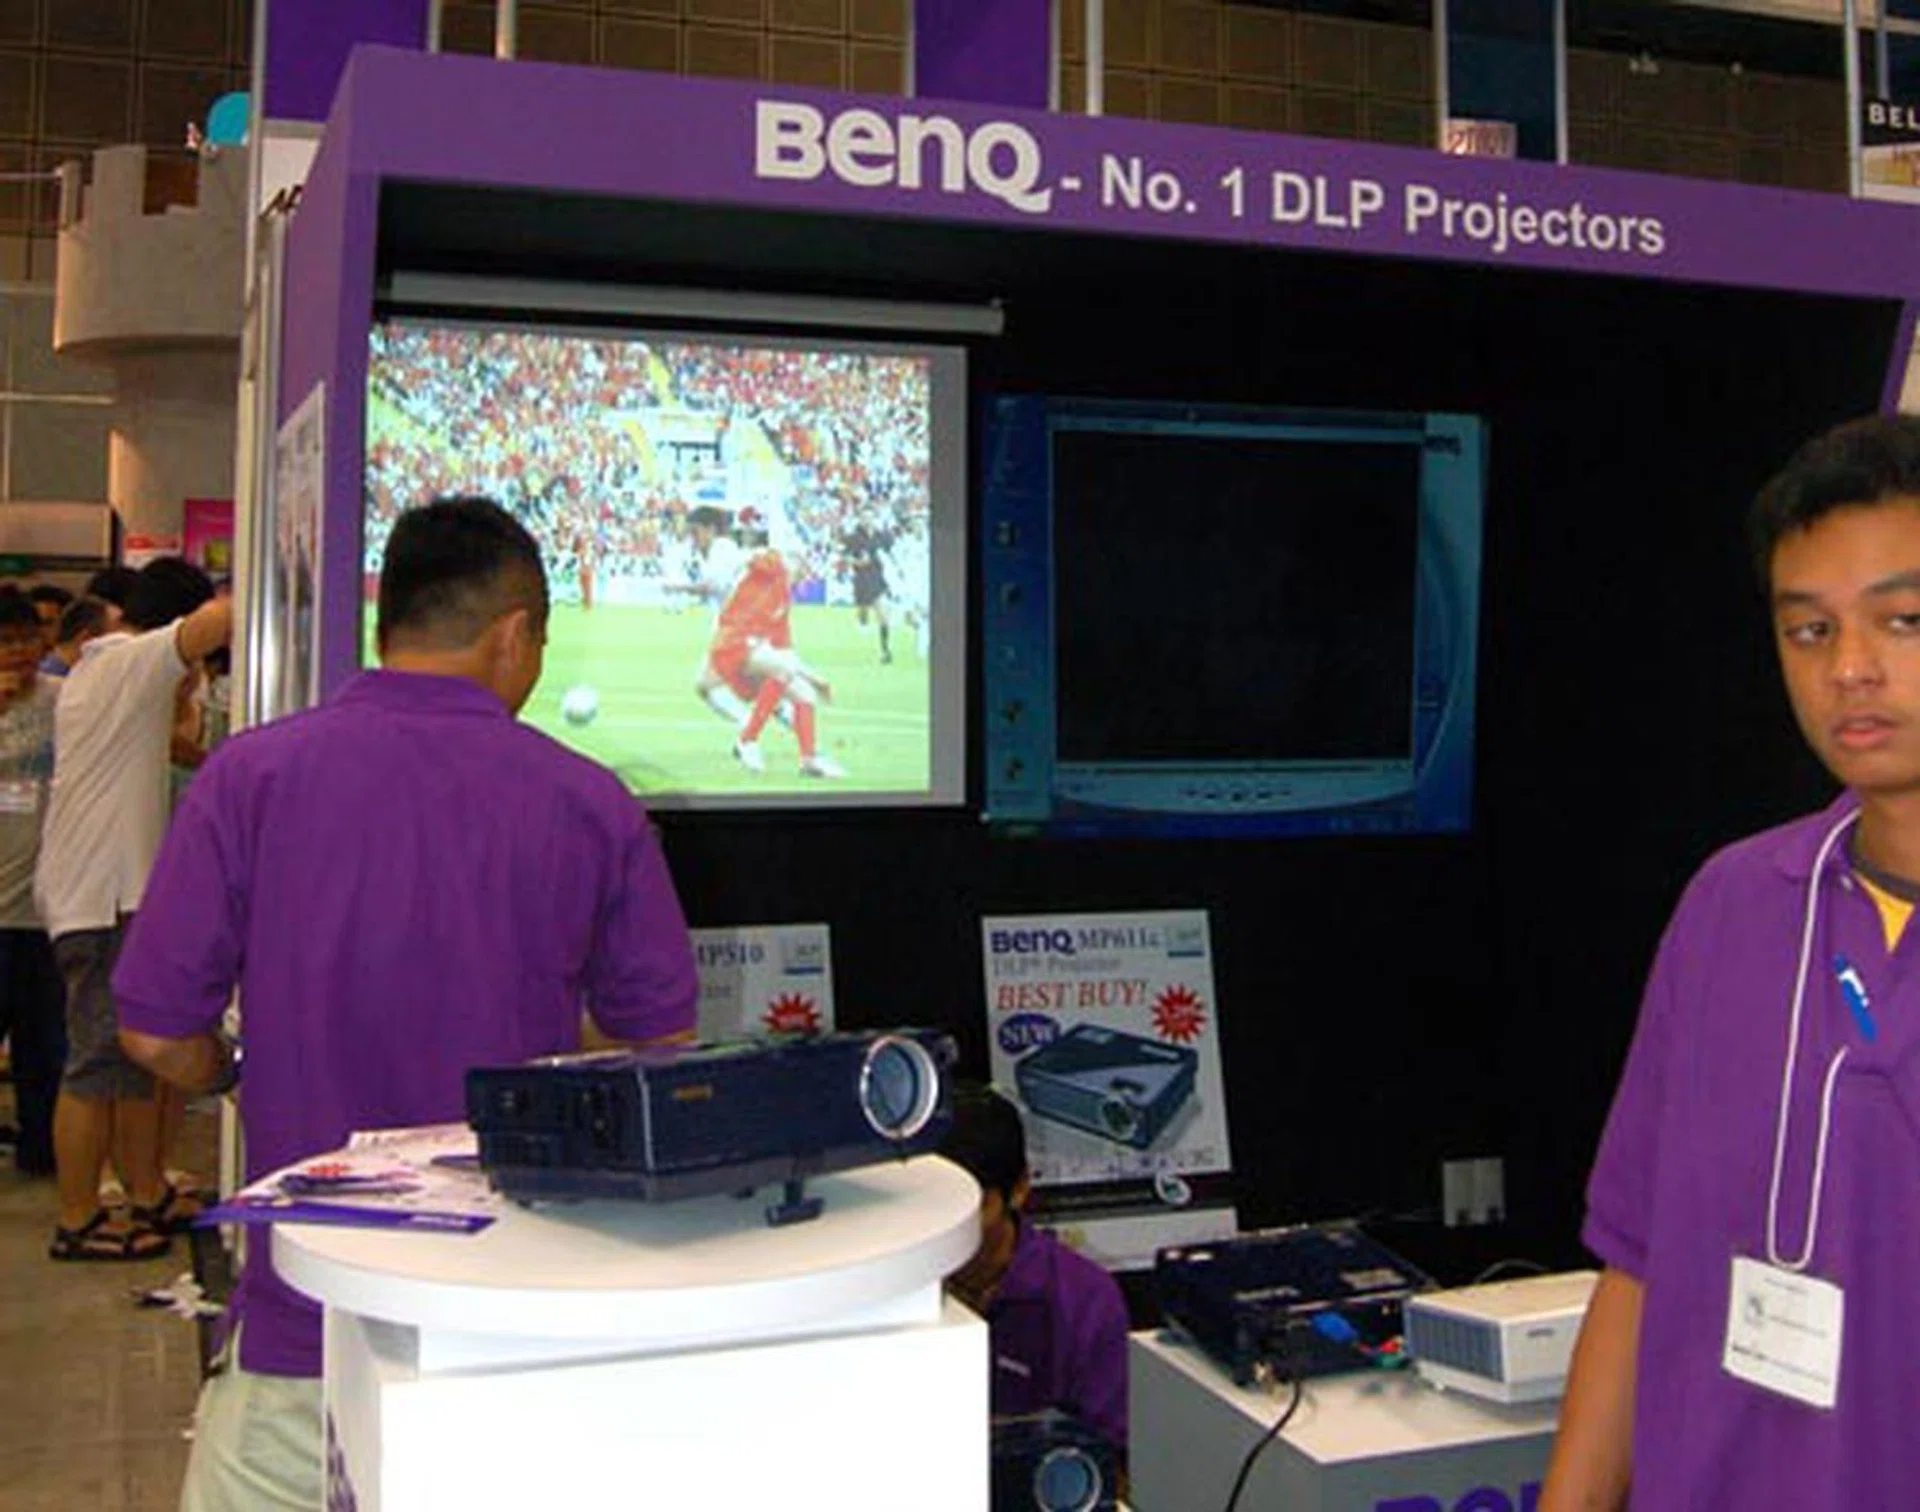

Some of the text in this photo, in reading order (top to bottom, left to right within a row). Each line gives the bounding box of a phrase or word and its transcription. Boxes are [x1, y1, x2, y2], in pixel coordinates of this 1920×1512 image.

[755, 99, 1052, 214] BenQ
[1100, 154, 1197, 215] No.
[1221, 166, 1245, 217] 1
[1271, 172, 1385, 230] DLP
[1403, 184, 1666, 256] Projectors
[990, 928, 1076, 955] BenQ
[996, 979, 1148, 1010] BEST BUY!
